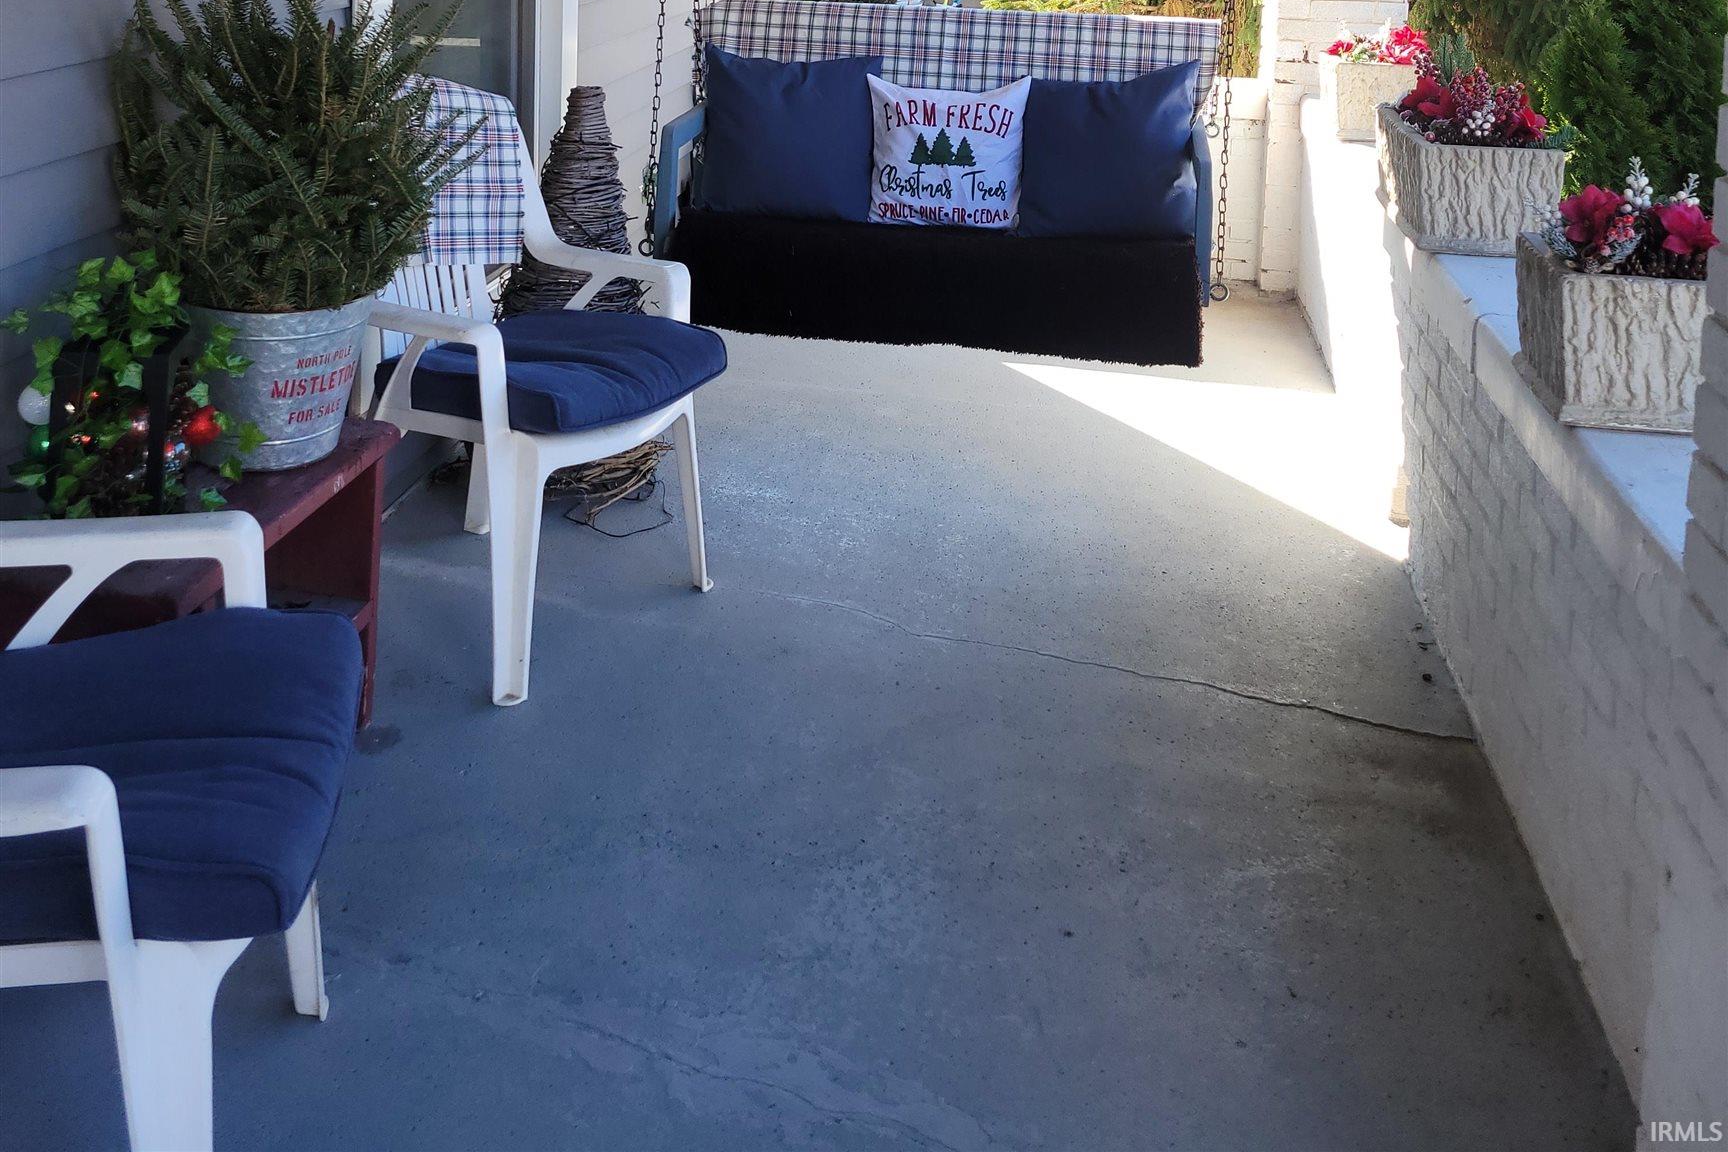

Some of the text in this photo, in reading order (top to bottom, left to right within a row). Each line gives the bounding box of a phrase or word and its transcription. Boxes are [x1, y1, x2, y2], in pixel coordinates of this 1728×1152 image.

[884, 100, 1014, 139] FARM FRESH
[879, 164, 1007, 201] Christmas Trees
[878, 203, 1009, 224] SPRUCE PINE FIR CEDAR
[297, 353, 331, 369] NORTH
[288, 398, 341, 424] FOR SALE
